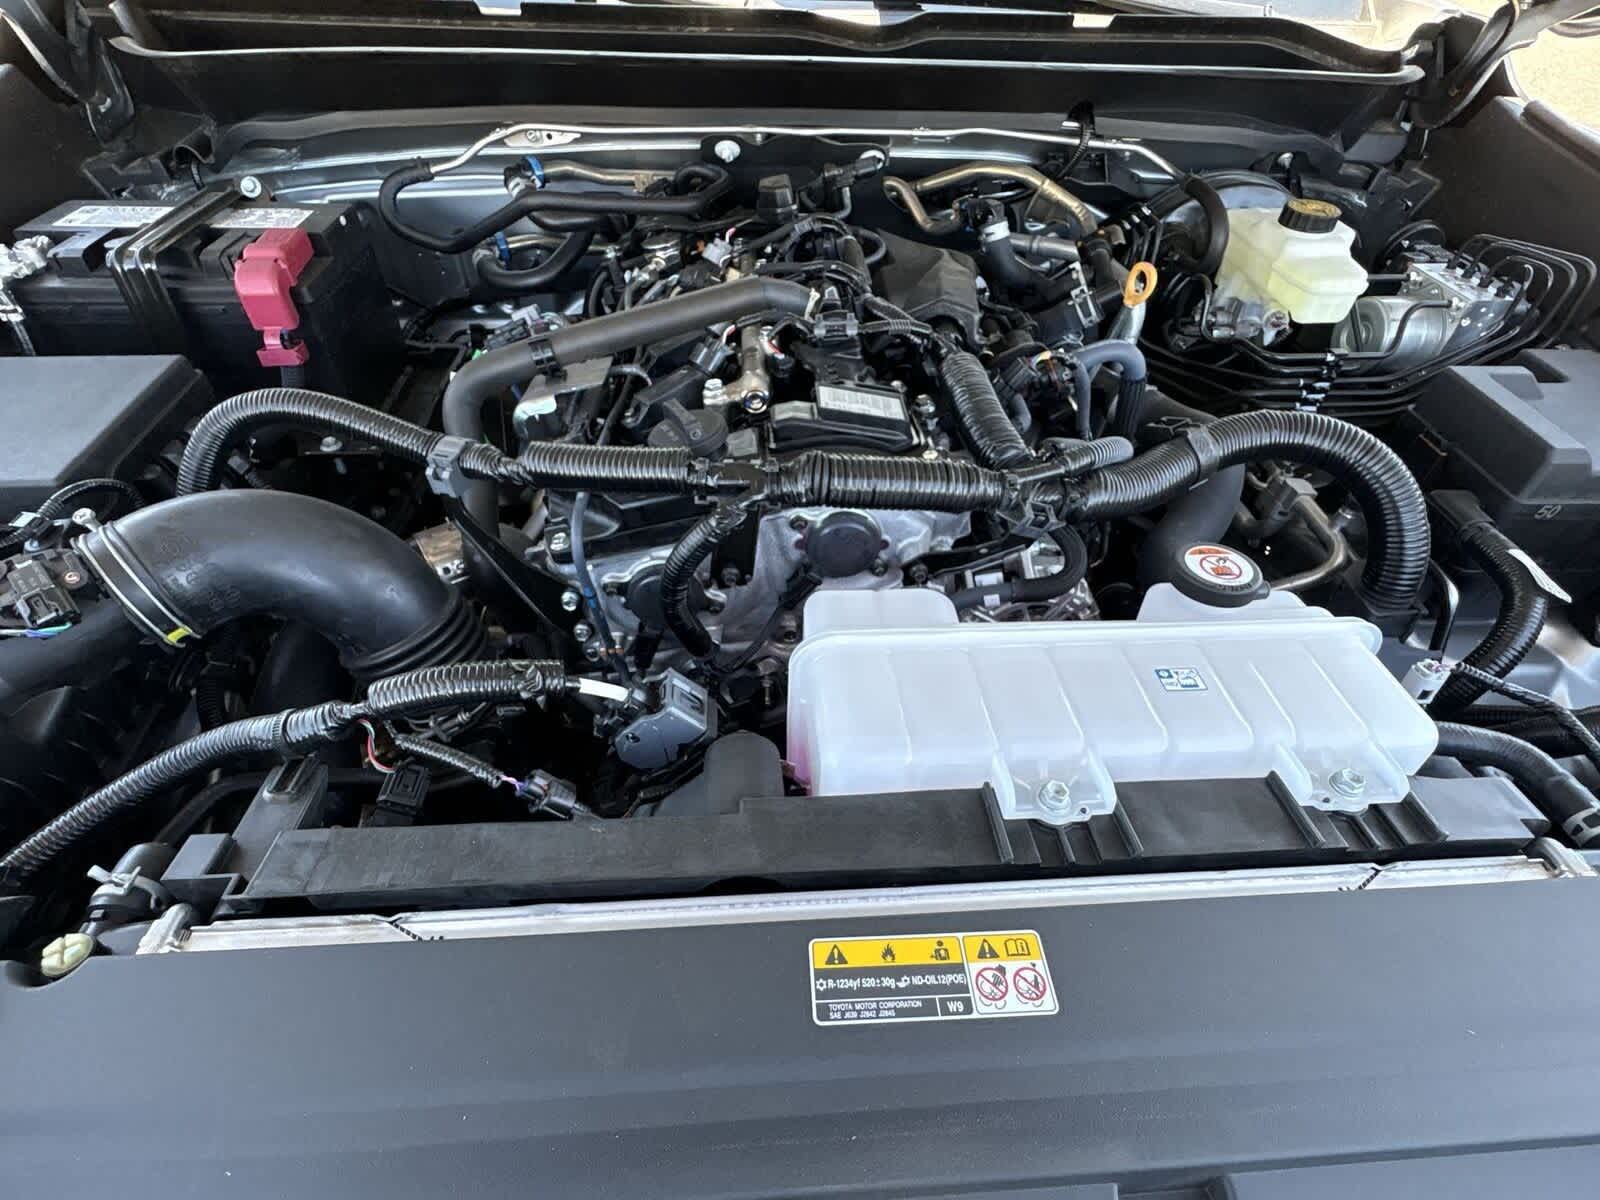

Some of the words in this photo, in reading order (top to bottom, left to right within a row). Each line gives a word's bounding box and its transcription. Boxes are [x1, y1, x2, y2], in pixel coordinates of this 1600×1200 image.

[828, 1003, 853, 1011] TOYOTA
[878, 1000, 922, 1009] CORPORATION
[946, 1000, 964, 1012] W9
